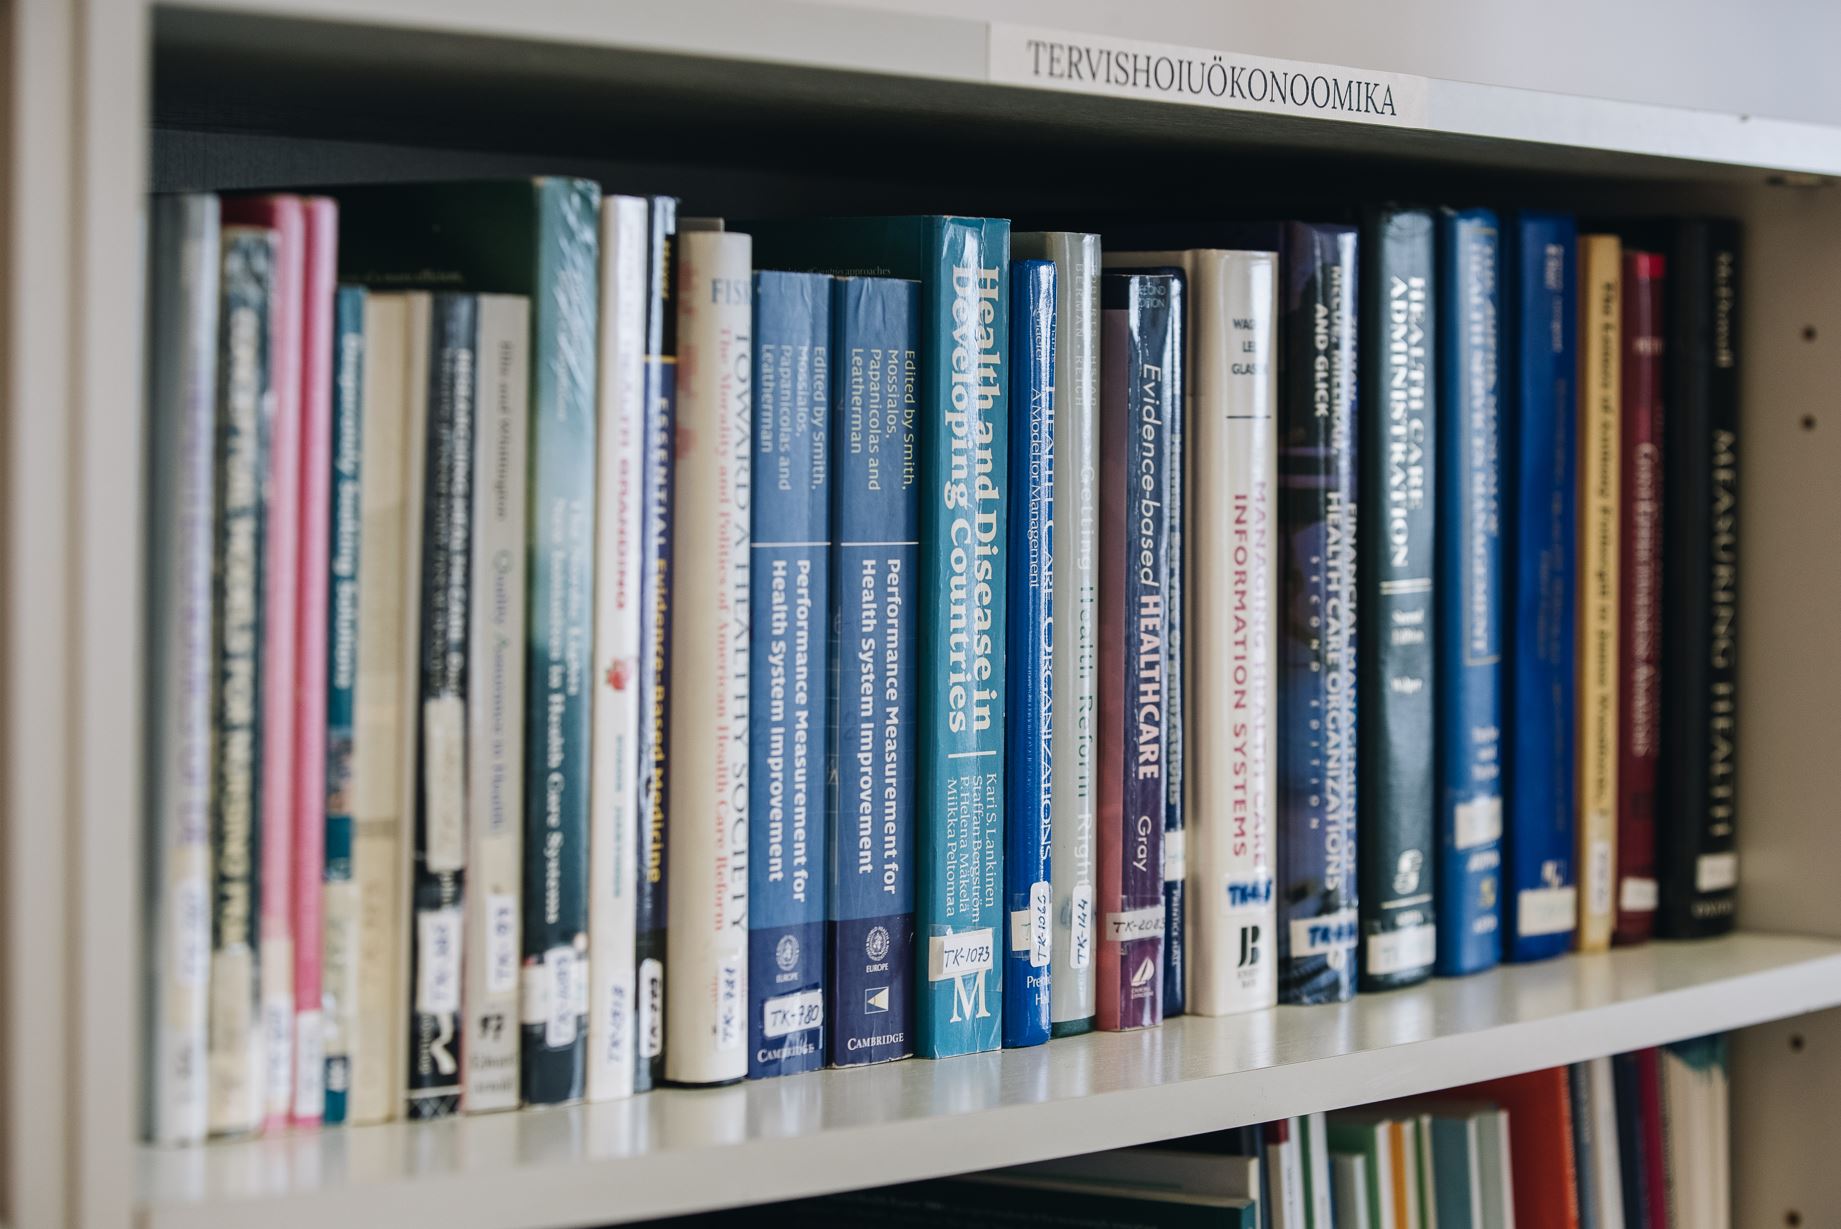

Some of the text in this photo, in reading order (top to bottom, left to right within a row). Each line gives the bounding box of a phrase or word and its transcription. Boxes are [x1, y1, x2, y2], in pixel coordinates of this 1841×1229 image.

[1026, 38, 1397, 117] TERVISHOIUÖKONOOMIKA
[761, 344, 775, 453] Leatherman
[777, 344, 793, 490] Papanicolas and
[795, 345, 809, 437] Mossialos,
[810, 346, 826, 490] Edited by Smith,
[851, 348, 864, 454] Leatherman
[867, 348, 882, 490] Papanicolas and
[885, 349, 899, 438] Mossialos,
[901, 350, 916, 490] Edited by Smith,
[1031, 387, 1042, 401] A
[1031, 404, 1042, 458] Model
[1390, 275, 1409, 568] ADMINISTRATION
[1407, 276, 1426, 511] HEALTH CARE
[943, 264, 974, 734] Developing Countries
[972, 265, 1000, 734] Health and Disease in
[1028, 483, 1042, 588] Management
[1030, 460, 1042, 478] for
[1309, 303, 1329, 829] AND GLICK SECOND EDITION
[1327, 491, 1343, 592] HEALTH
[1711, 429, 1736, 669] MEASURING
[651, 558, 668, 762] Evidence-Based
[713, 328, 733, 932] The Morality and Politics of American Health Care Reform
[731, 327, 750, 930] TOWARD A HEALTHY SOCIETY
[1079, 586, 1095, 680] Health
[1132, 363, 1163, 872] Evidence-based HEALTHCARE Gray
[1233, 493, 1248, 858] INFORMATION SYSTEMS
[1326, 598, 1342, 667] CARE
[767, 560, 788, 882] Health System Improvement
[791, 560, 812, 902] Performance Measurement for
[857, 559, 877, 874] Health System Improvement
[883, 559, 901, 895] Performance Measurement for
[1078, 695, 1095, 798] Reform
[1325, 670, 1342, 891] ORGANIZATIONS
[1345, 646, 1358, 830] MANAGEMENT
[1709, 681, 1735, 838] HEALTH
[546, 773, 565, 828] Care
[647, 766, 665, 883] Medicine
[946, 778, 958, 917] Miikka Peltomaa
[959, 776, 970, 912] P. Helena Mäkelä
[969, 774, 984, 923] Staffan Bergström
[985, 771, 997, 907] Kari S. Lankinen
[1345, 842, 1357, 874] OF
[866, 962, 889, 973] EUROPE
[944, 945, 990, 968] TK-1073
[950, 969, 991, 1023] M
[847, 1033, 904, 1051] CAMBRIDGE
